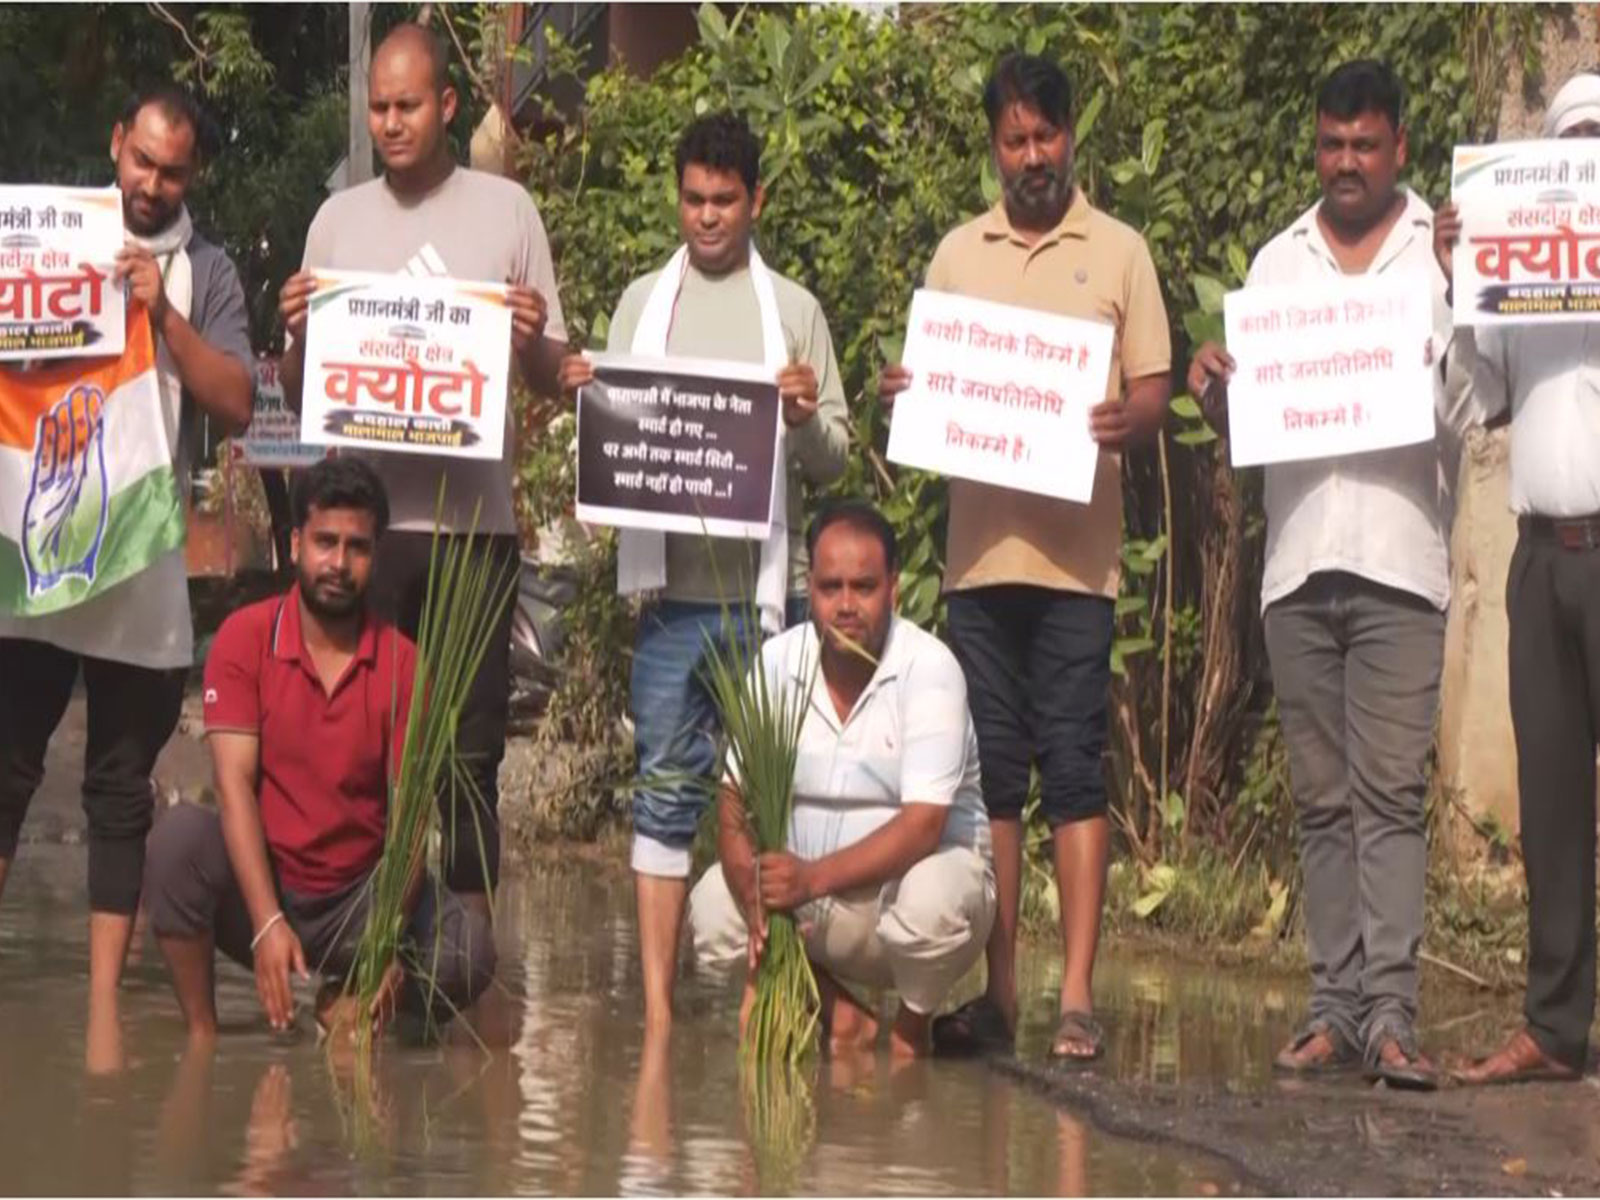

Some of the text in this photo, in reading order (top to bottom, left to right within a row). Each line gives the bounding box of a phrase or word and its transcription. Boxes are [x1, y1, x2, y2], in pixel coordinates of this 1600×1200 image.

[37, 205, 57, 230] जी
[62, 211, 83, 230] का
[348, 297, 472, 325] प्रधानमंत्री जी का
[322, 359, 489, 418] क्योटो
[927, 371, 1065, 416] सारे जनप्रतिनिधि
